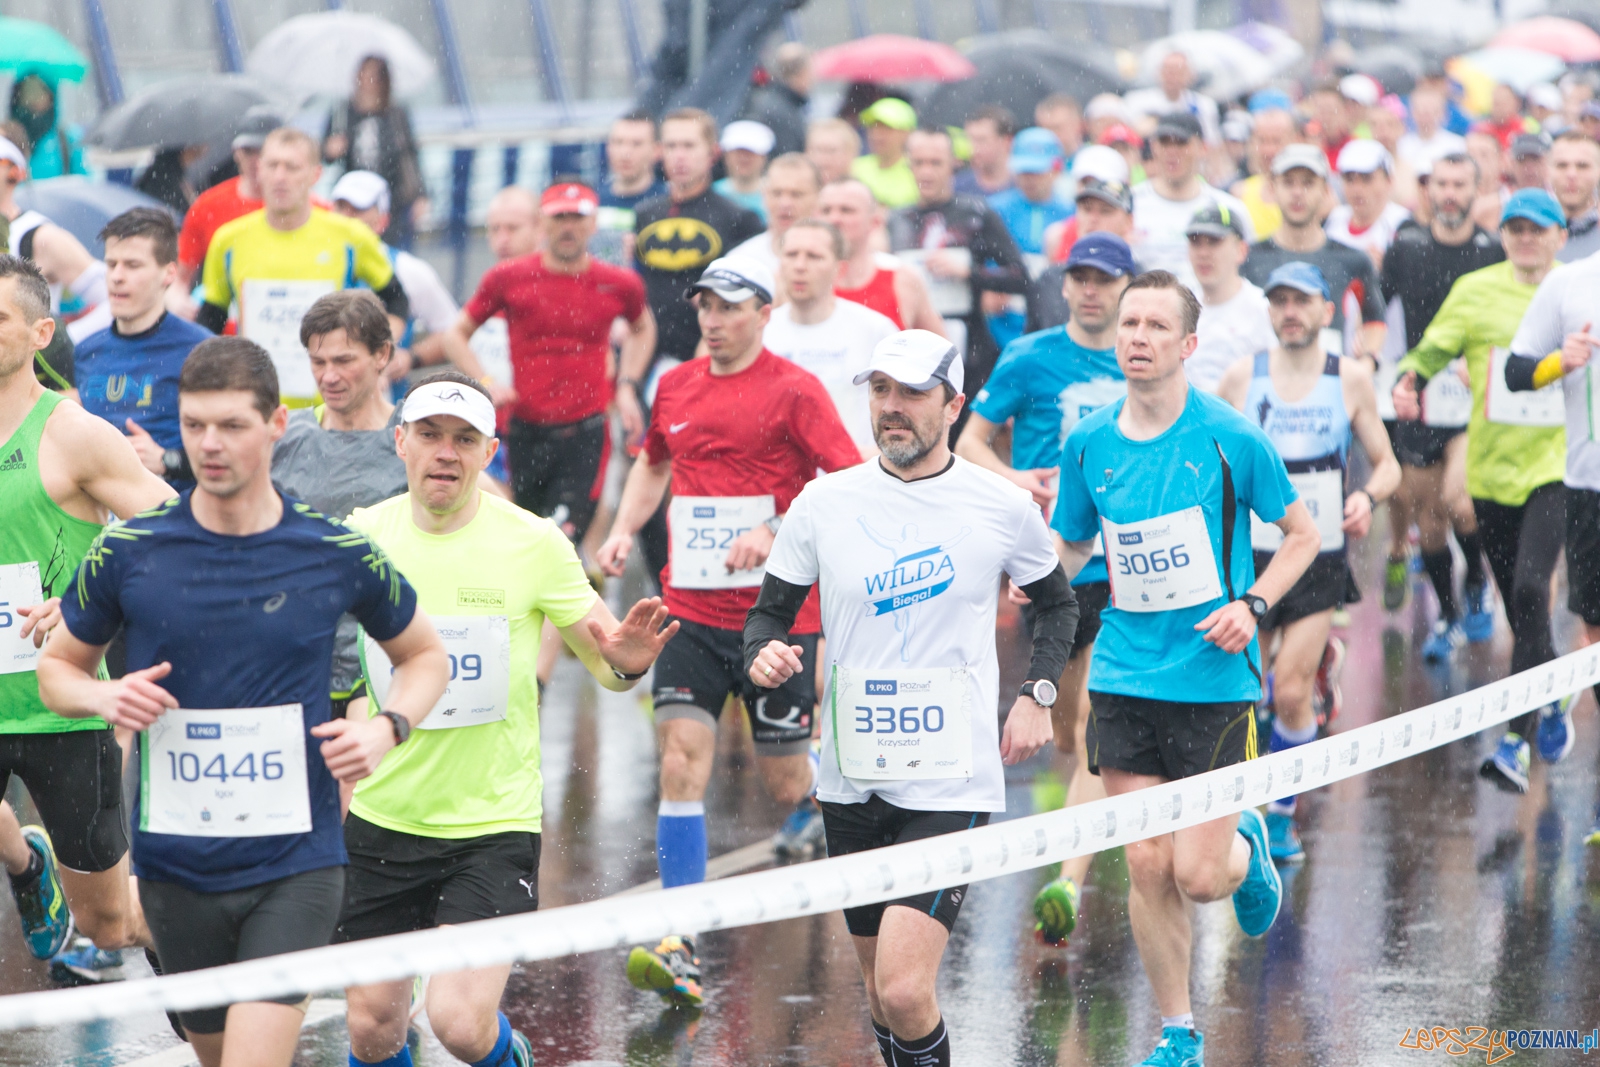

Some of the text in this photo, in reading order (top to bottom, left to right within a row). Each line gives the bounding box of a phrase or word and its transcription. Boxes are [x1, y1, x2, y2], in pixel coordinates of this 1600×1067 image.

[1117, 543, 1190, 576] 3066
[864, 554, 955, 596] WILDA
[460, 597, 502, 605] TRIATHLON
[892, 586, 932, 609] Biega!
[868, 683, 894, 693] 9.PKO
[855, 705, 944, 734] 3360
[877, 738, 921, 748] Krzysztof
[167, 751, 284, 783] 10446
